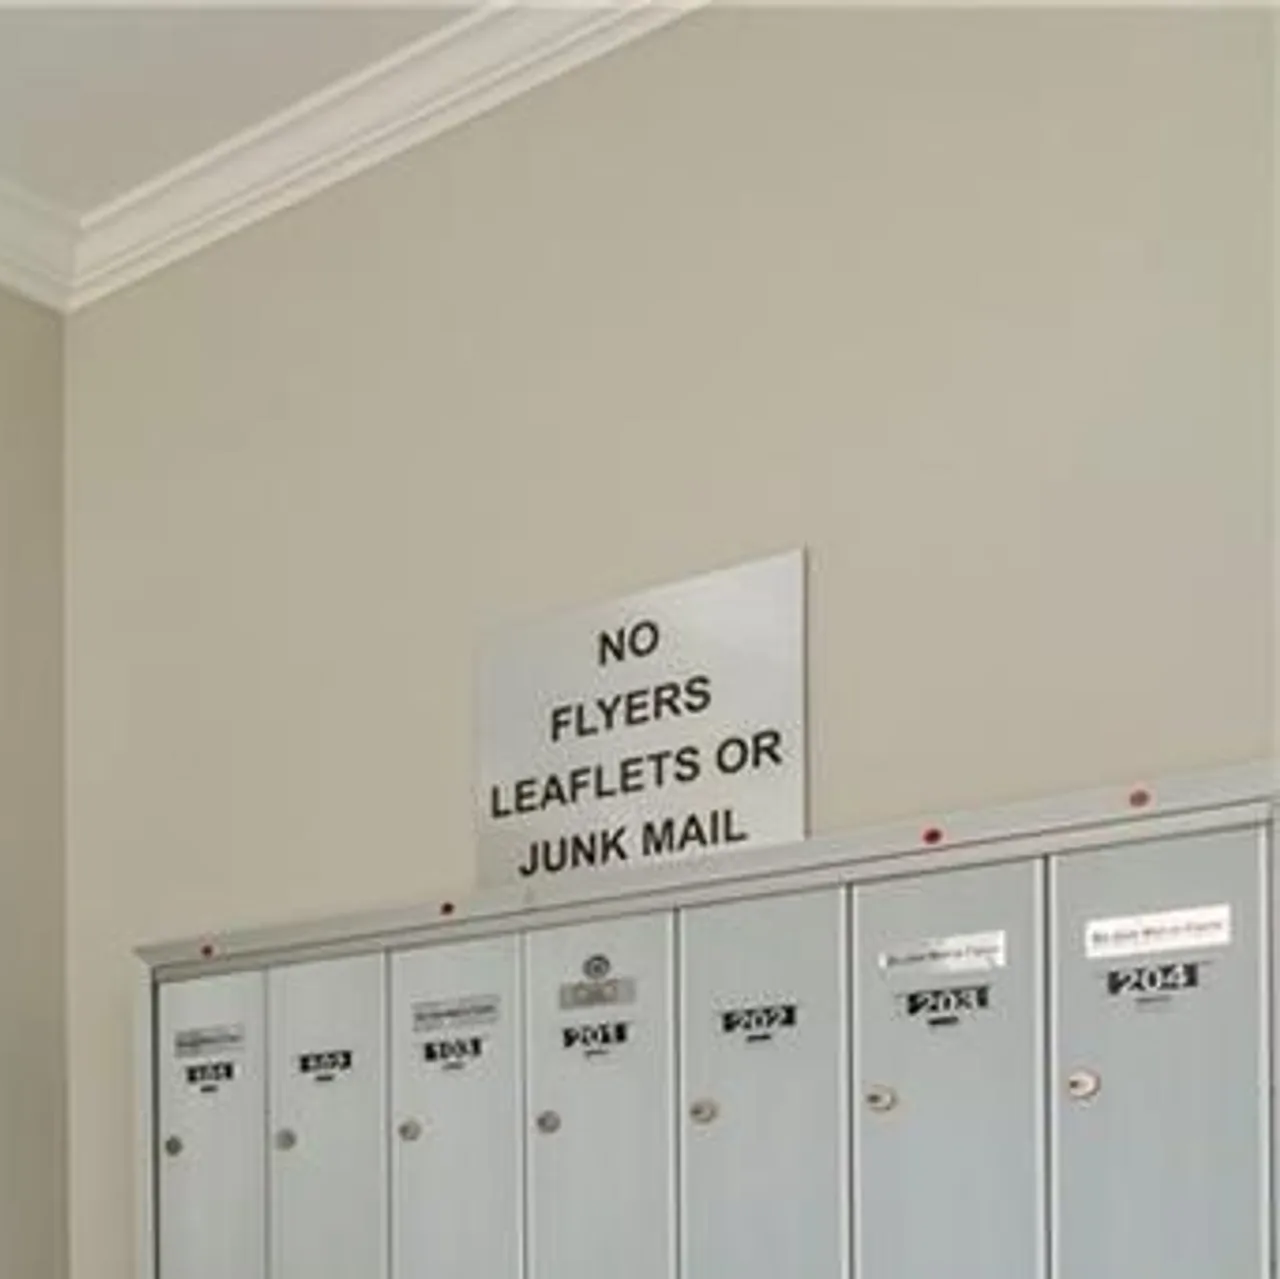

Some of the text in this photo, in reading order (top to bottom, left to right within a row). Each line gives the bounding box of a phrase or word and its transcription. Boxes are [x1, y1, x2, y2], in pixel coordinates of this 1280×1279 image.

[598, 620, 659, 665] NO
[551, 676, 711, 742] FLYERS
[491, 730, 782, 819] LEAFLETS OR
[519, 809, 748, 877] JUNK MAIL
[1116, 963, 1187, 992] 204
[732, 1006, 785, 1031] 202
